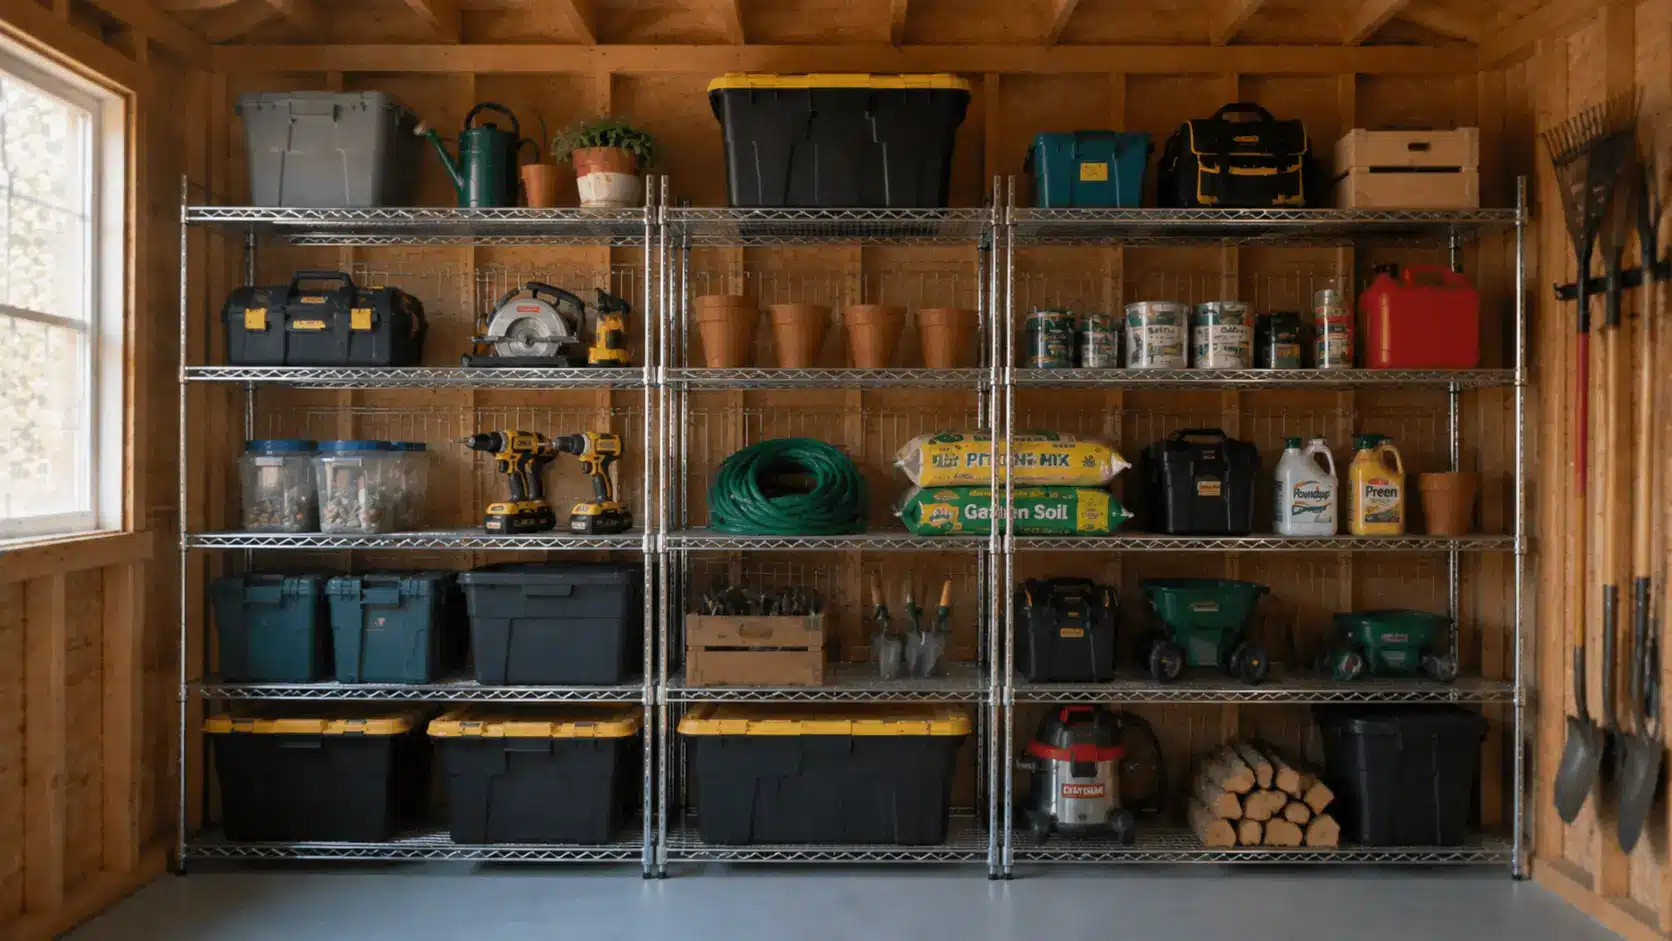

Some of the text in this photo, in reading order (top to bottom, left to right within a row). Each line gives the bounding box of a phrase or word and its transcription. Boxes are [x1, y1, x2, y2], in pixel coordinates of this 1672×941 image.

[1365, 485, 1398, 498] Preen
[964, 503, 1029, 520] Gaen
[1034, 503, 1069, 520] Soil
